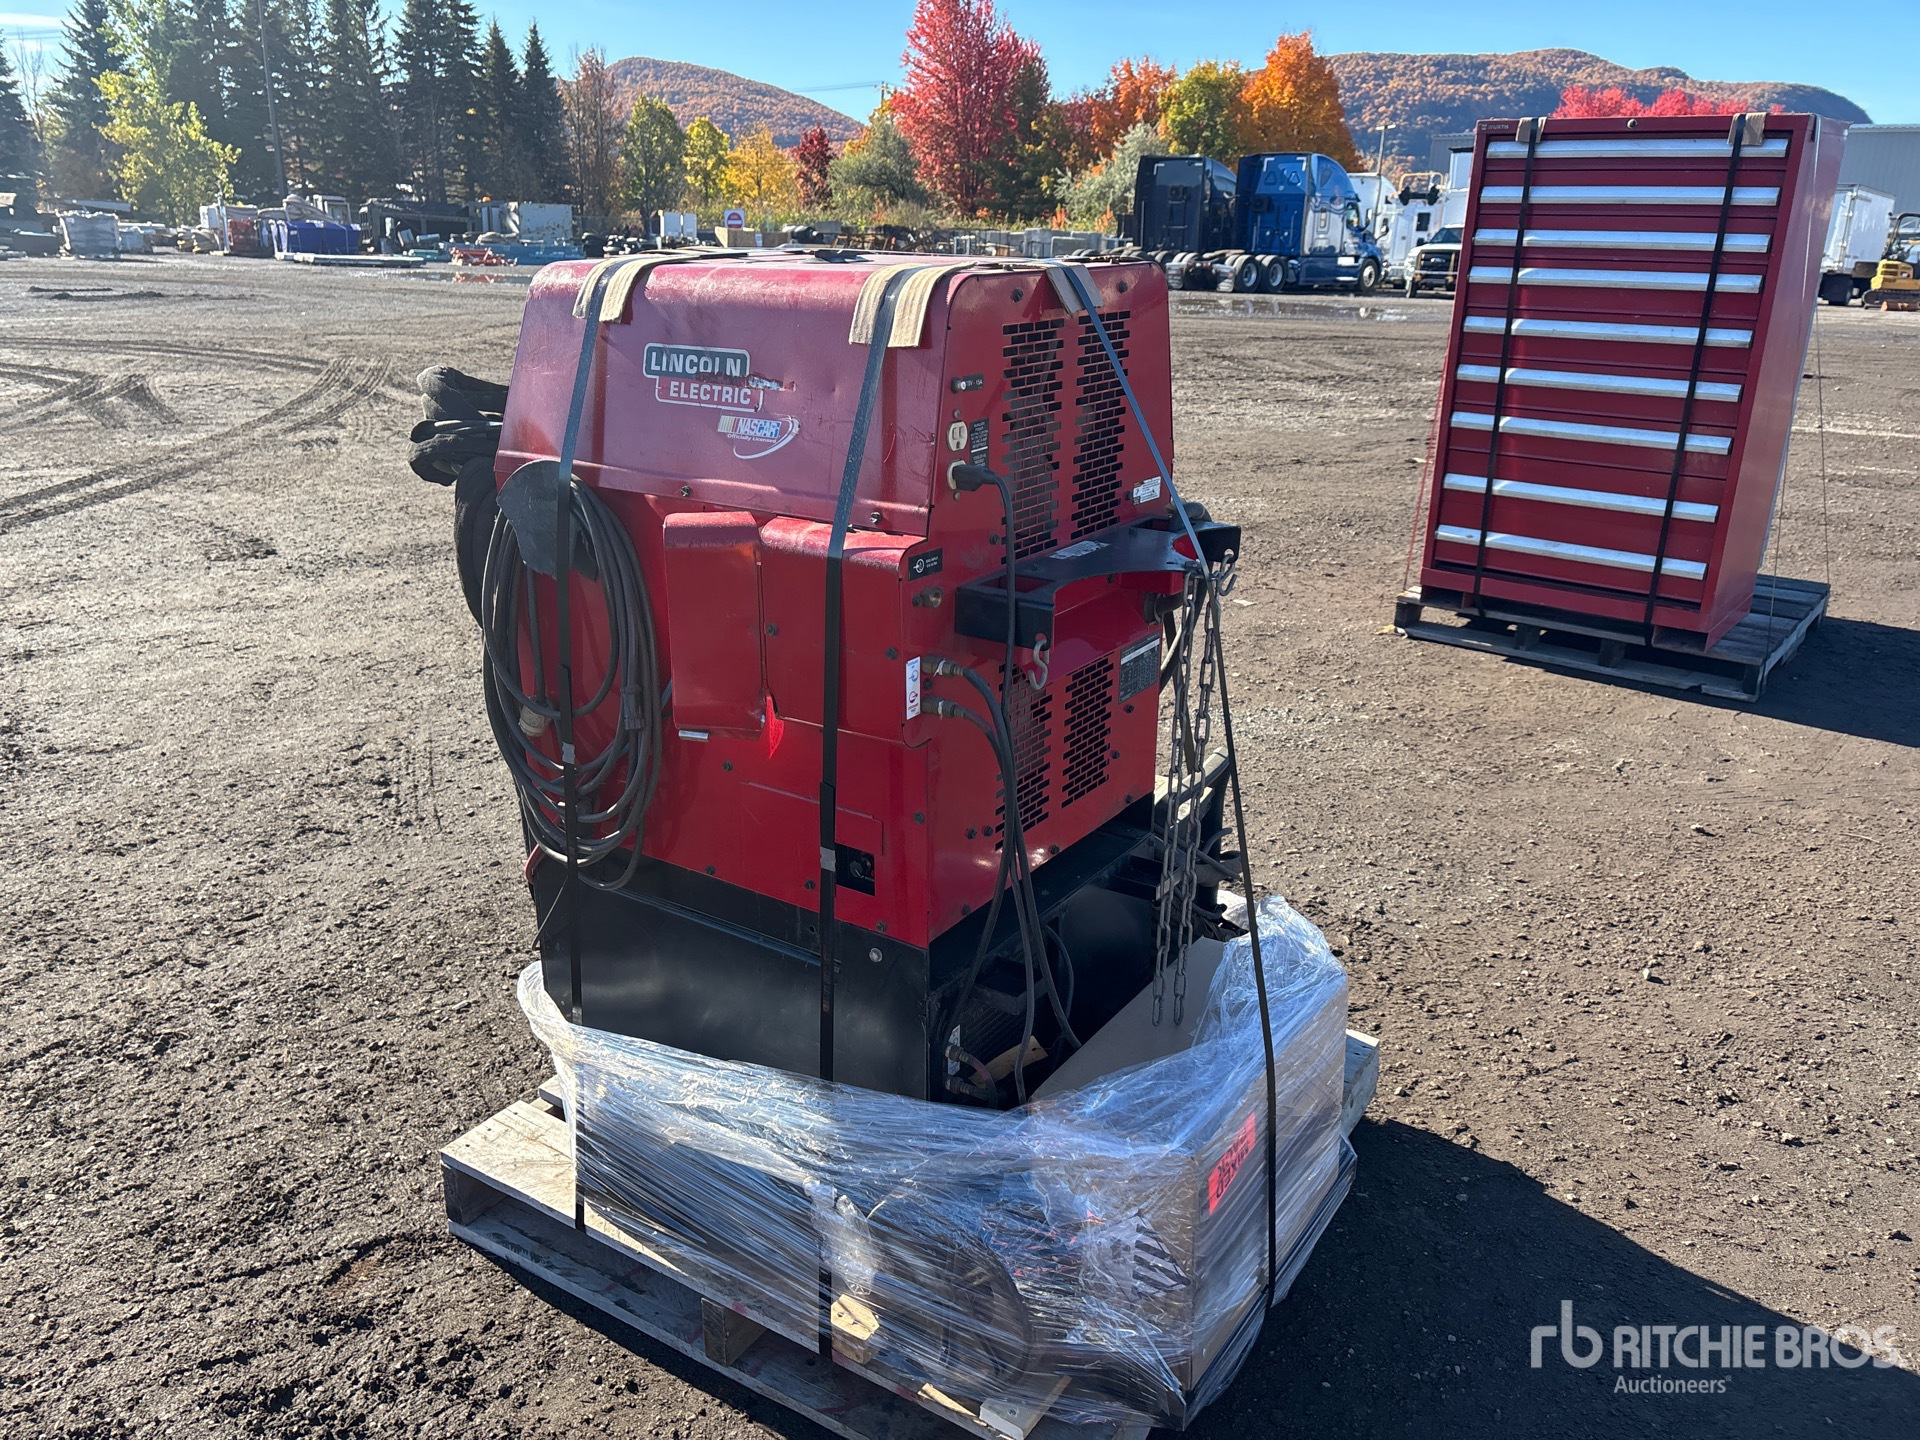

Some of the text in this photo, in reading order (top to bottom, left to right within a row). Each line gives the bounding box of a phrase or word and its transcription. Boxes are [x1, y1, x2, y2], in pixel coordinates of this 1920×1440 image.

[669, 381, 751, 405] ELECTRIC
[727, 433, 777, 443] Officially Licensed
[737, 418, 780, 438] NASCAR
